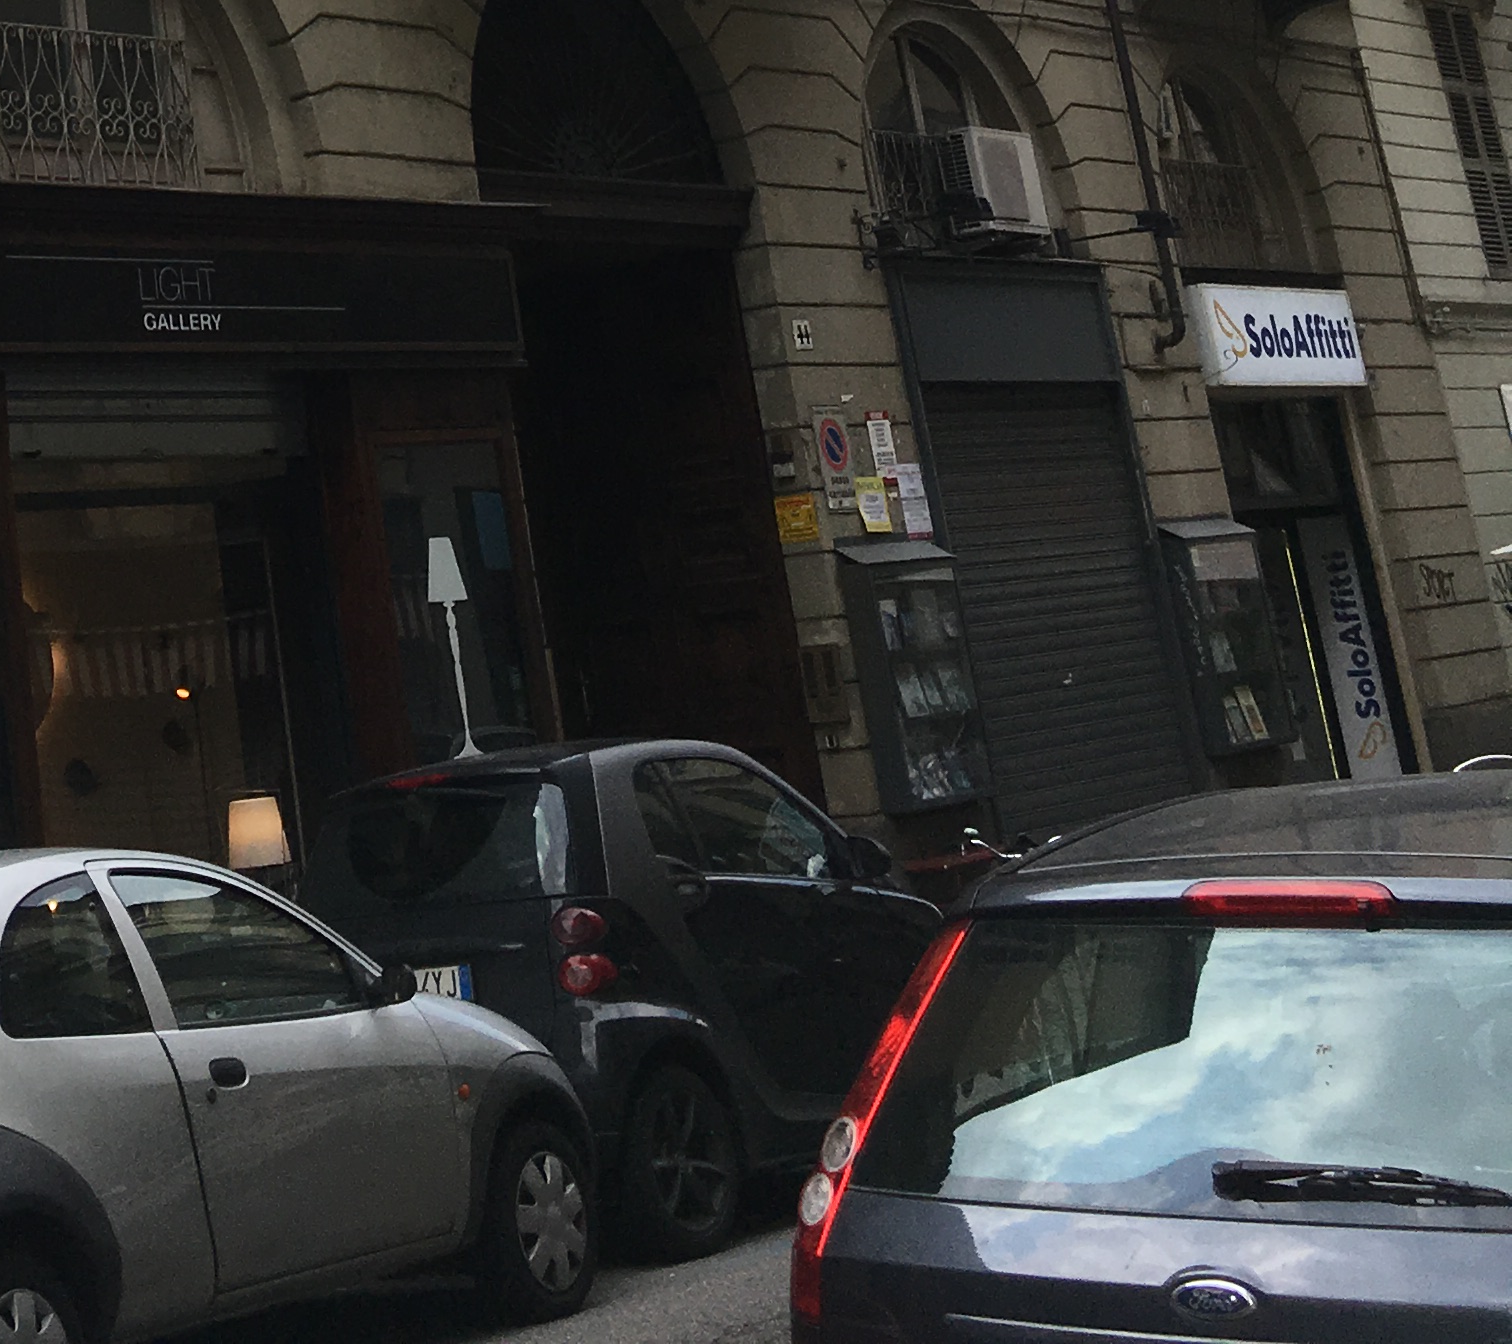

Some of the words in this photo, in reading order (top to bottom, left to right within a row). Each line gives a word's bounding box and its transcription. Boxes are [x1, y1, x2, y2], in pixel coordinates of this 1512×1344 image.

[138, 266, 215, 301] LIGHT
[143, 312, 222, 331] GALLERY
[1244, 313, 1357, 360] SoloAffitti
[1321, 550, 1381, 719] SoloAffitti
